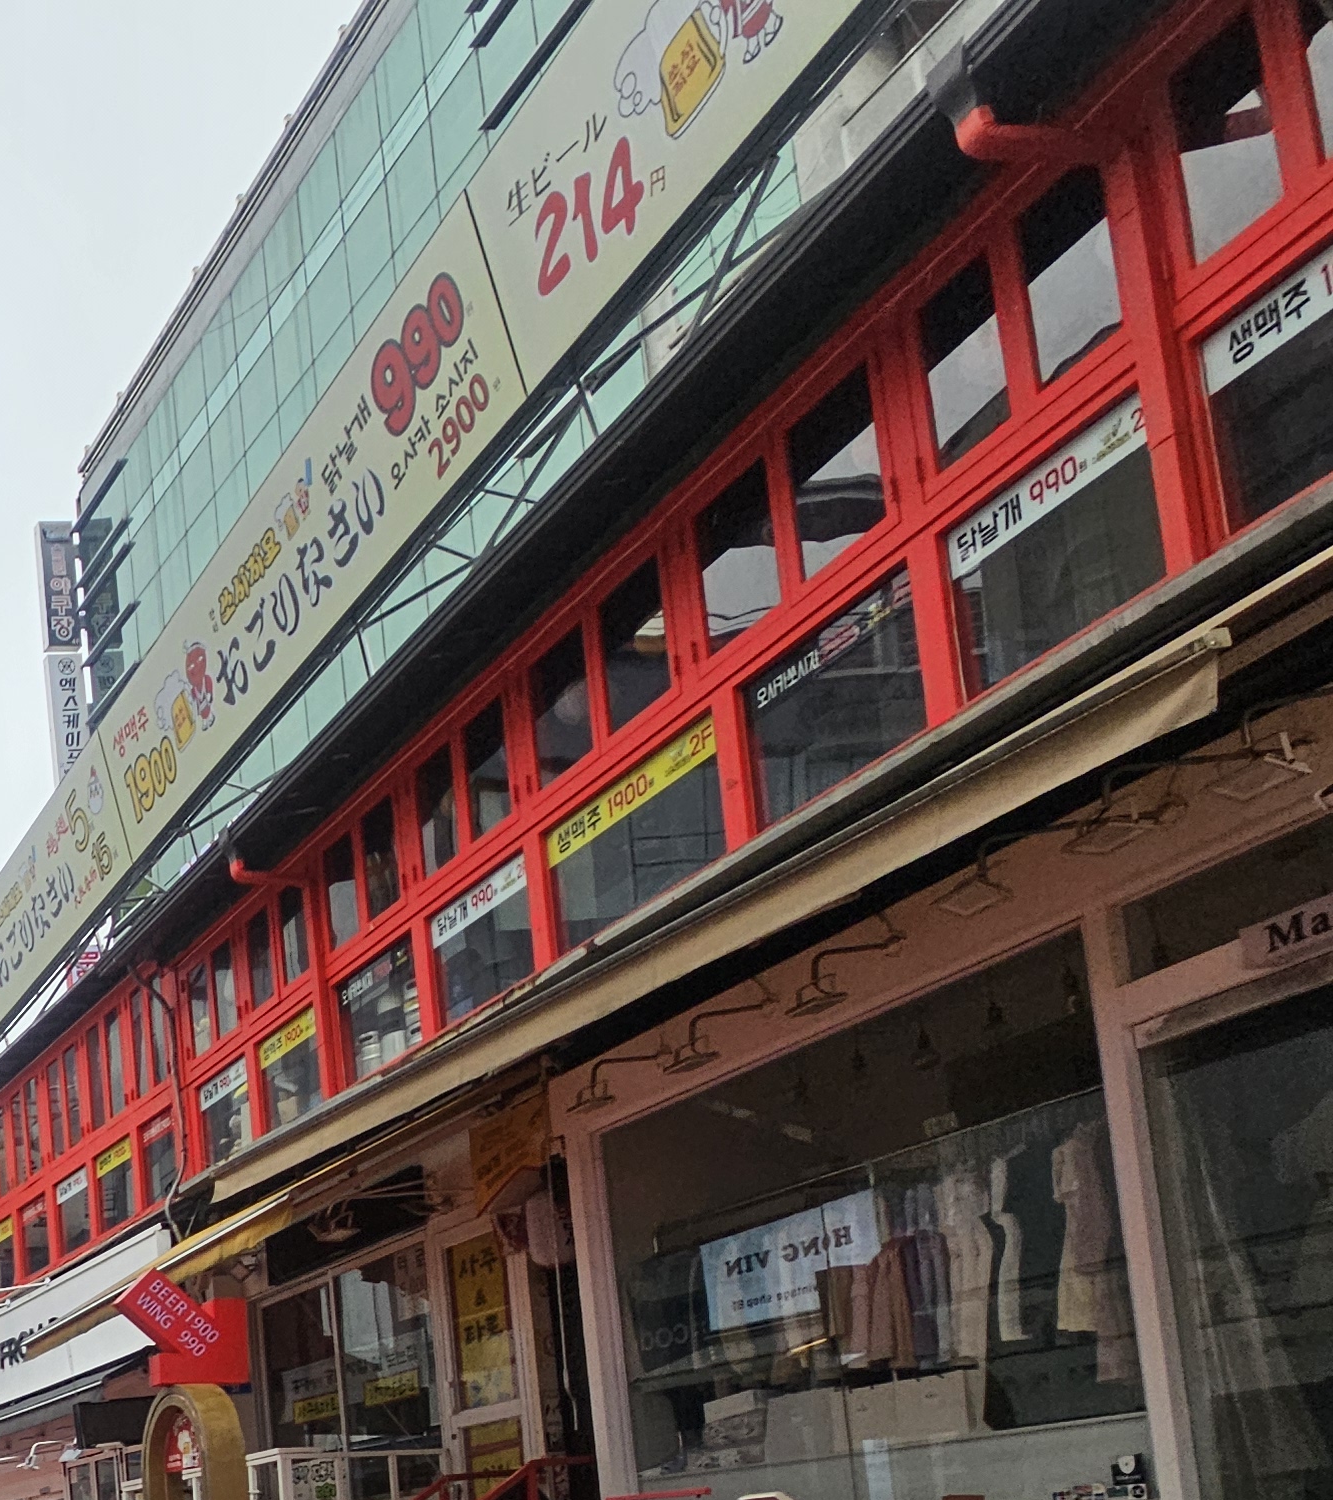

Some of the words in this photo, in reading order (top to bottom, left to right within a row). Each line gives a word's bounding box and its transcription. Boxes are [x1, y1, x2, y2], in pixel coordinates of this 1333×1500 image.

[506, 112, 608, 228] 生ビール
[1228, 276, 1312, 366] 생맥주
[321, 394, 374, 497] 닭날개
[389, 413, 434, 492] 오사카
[434, 337, 481, 421] 소시지
[955, 492, 1023, 564] 닭날개
[112, 705, 150, 759] 생맥주
[123, 734, 178, 825] 1900
[557, 804, 602, 855] 생맥주
[689, 723, 713, 758] 2F
[436, 898, 469, 938] 닭날개
[457, 1249, 500, 1280] 사주
[136, 1291, 175, 1330] WING
[176, 1329, 207, 1358] 990
[147, 1278, 187, 1317] BEER
[183, 1310, 221, 1345] 1900
